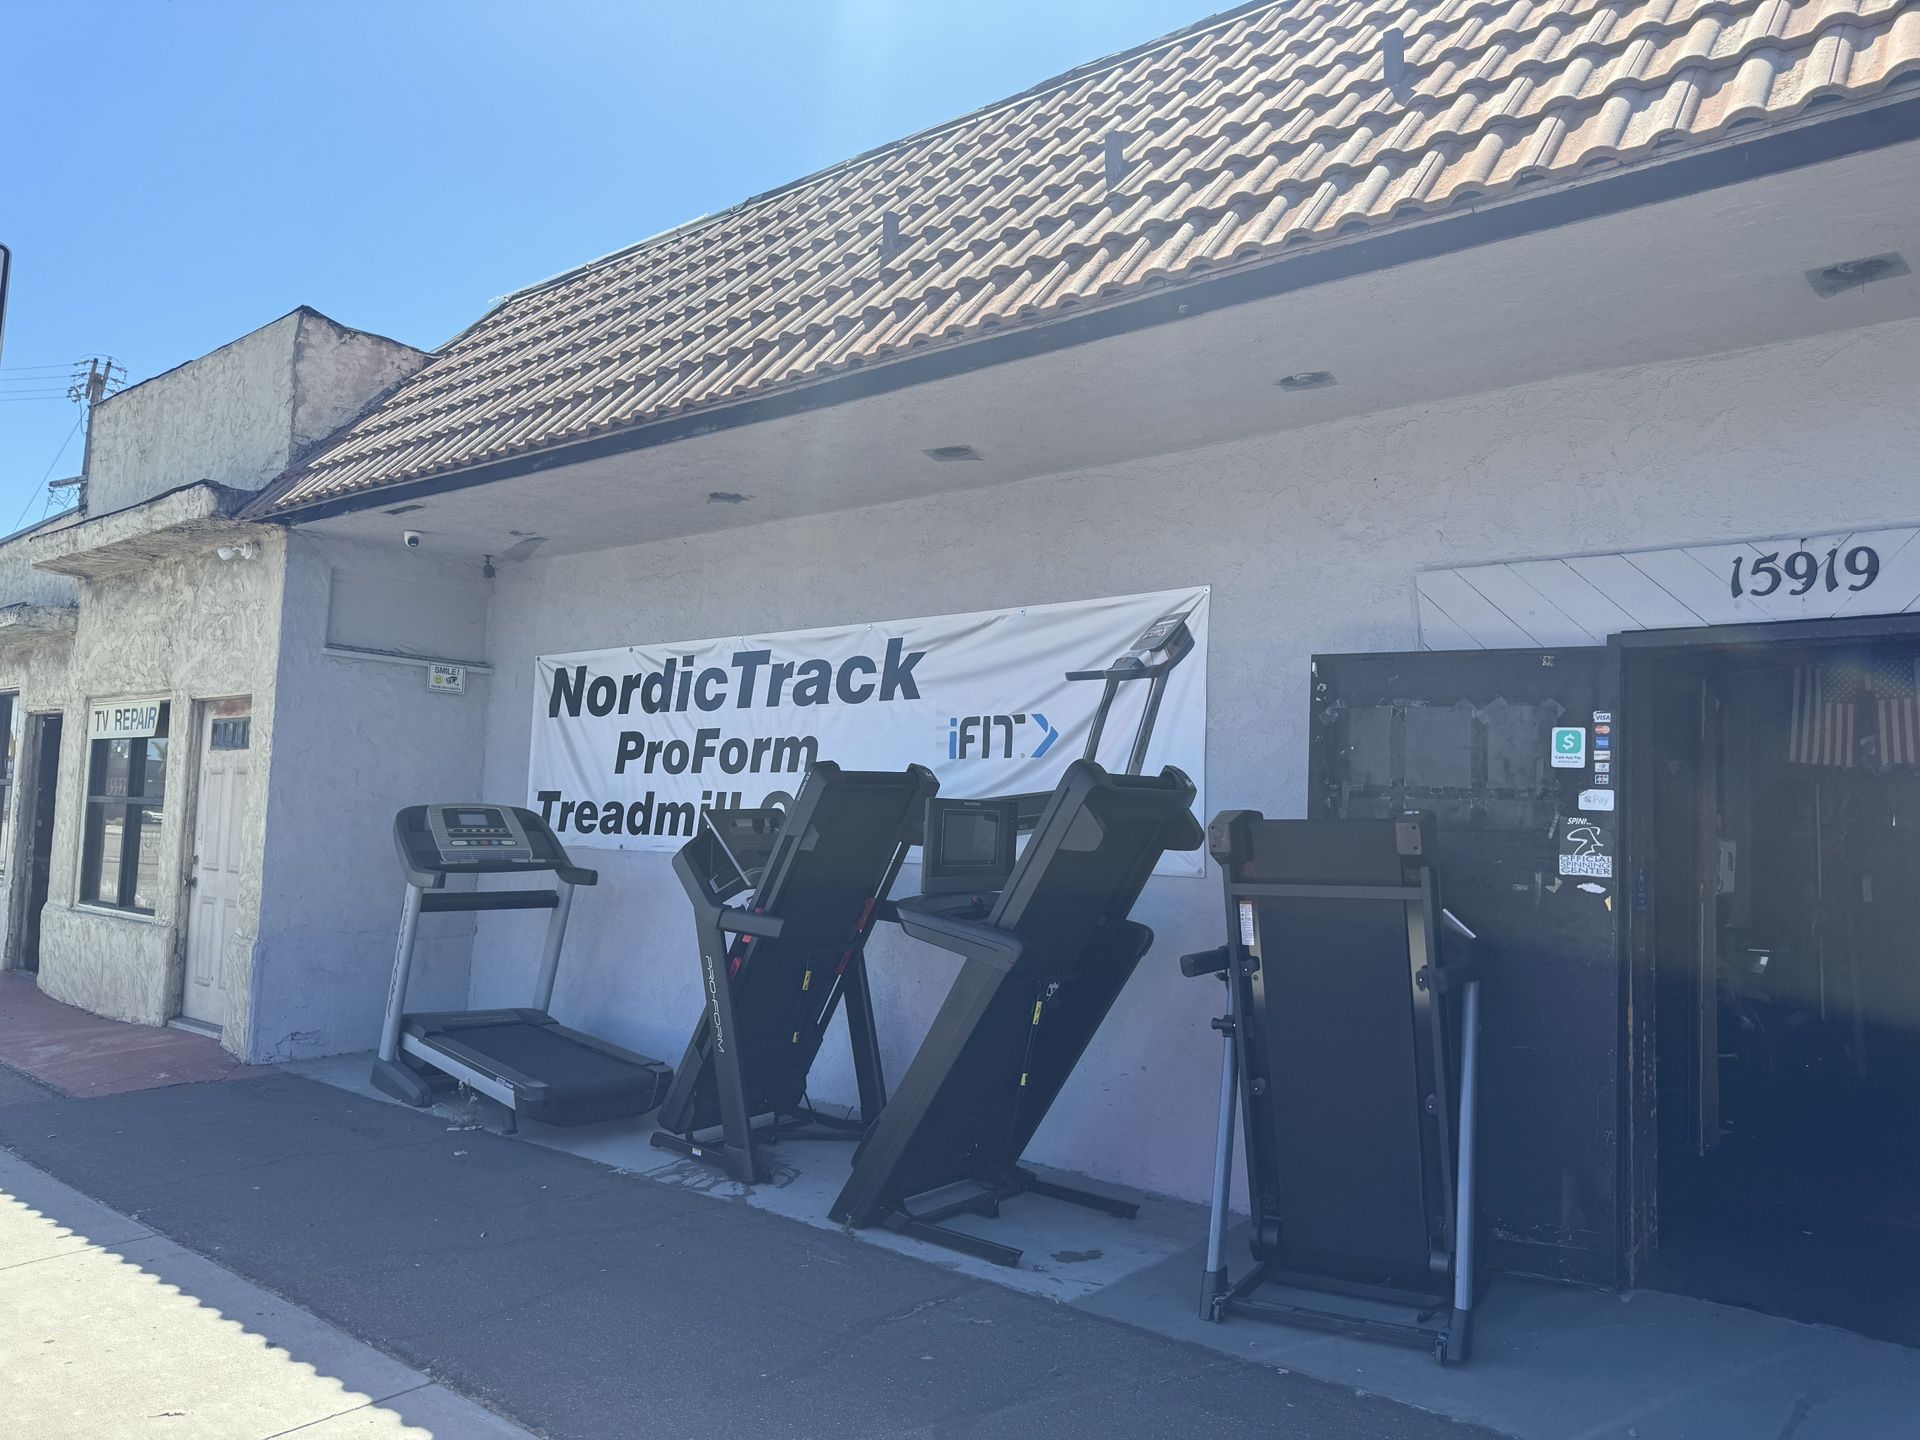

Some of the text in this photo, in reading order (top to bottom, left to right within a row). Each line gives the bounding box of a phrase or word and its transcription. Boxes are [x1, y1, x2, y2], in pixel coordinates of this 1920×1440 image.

[1731, 546, 1880, 598] 15919
[548, 637, 927, 719] NordicTrack
[95, 707, 157, 732] TV REPAIR
[948, 713, 1026, 760] iFIT
[614, 728, 819, 774] ProForm
[1593, 796, 1609, 806] Pay
[1560, 861, 1610, 869] SPINNING
[706, 955, 725, 1054] PRO-FORM
